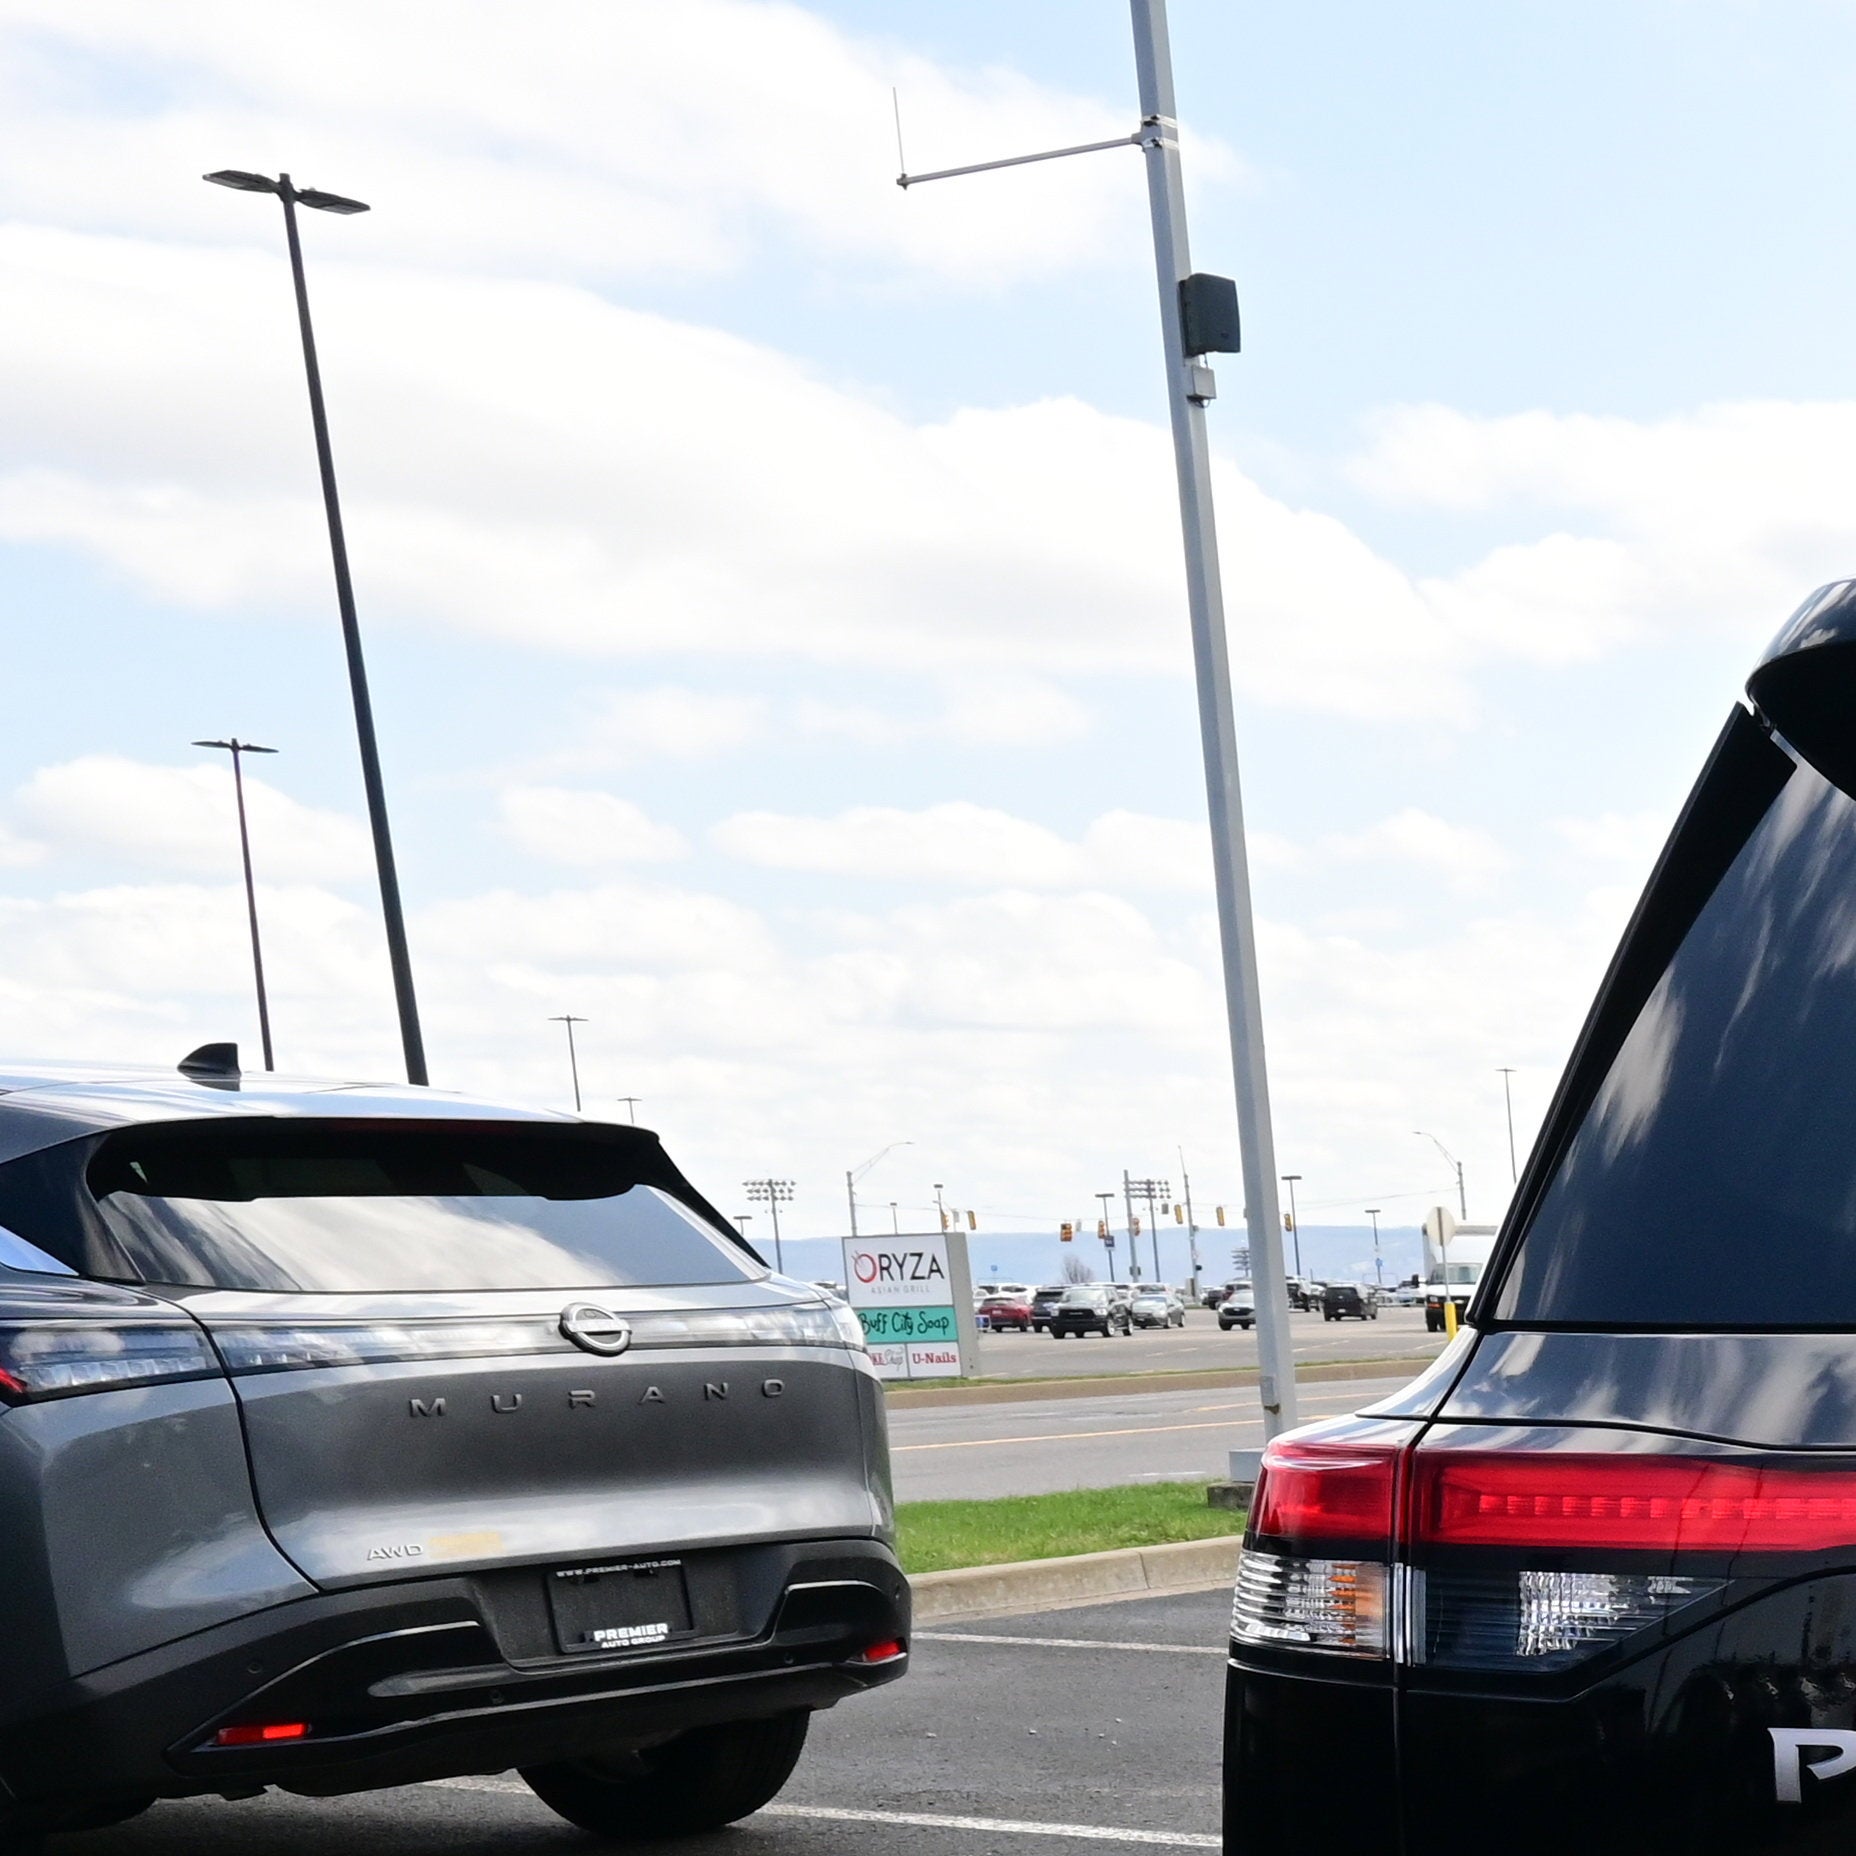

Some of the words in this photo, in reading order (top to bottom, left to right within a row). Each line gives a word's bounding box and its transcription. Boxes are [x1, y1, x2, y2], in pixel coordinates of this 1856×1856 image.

[852, 1251, 944, 1283] ORYZA
[871, 1286, 899, 1294] ASIAN
[903, 1285, 930, 1294] GRILL
[858, 1312, 888, 1335] Buff
[891, 1311, 914, 1335] City
[917, 1311, 950, 1336] Soap
[912, 1352, 957, 1364] U-Nails
[408, 1378, 786, 1418] MURANO
[366, 1544, 422, 1561] AWD
[556, 1559, 681, 1577] WWW.PREMIER-AUTO.COM
[593, 1623, 668, 1642] PREMIER
[601, 1639, 629, 1648] AUTO
[631, 1635, 666, 1645] GROUP
